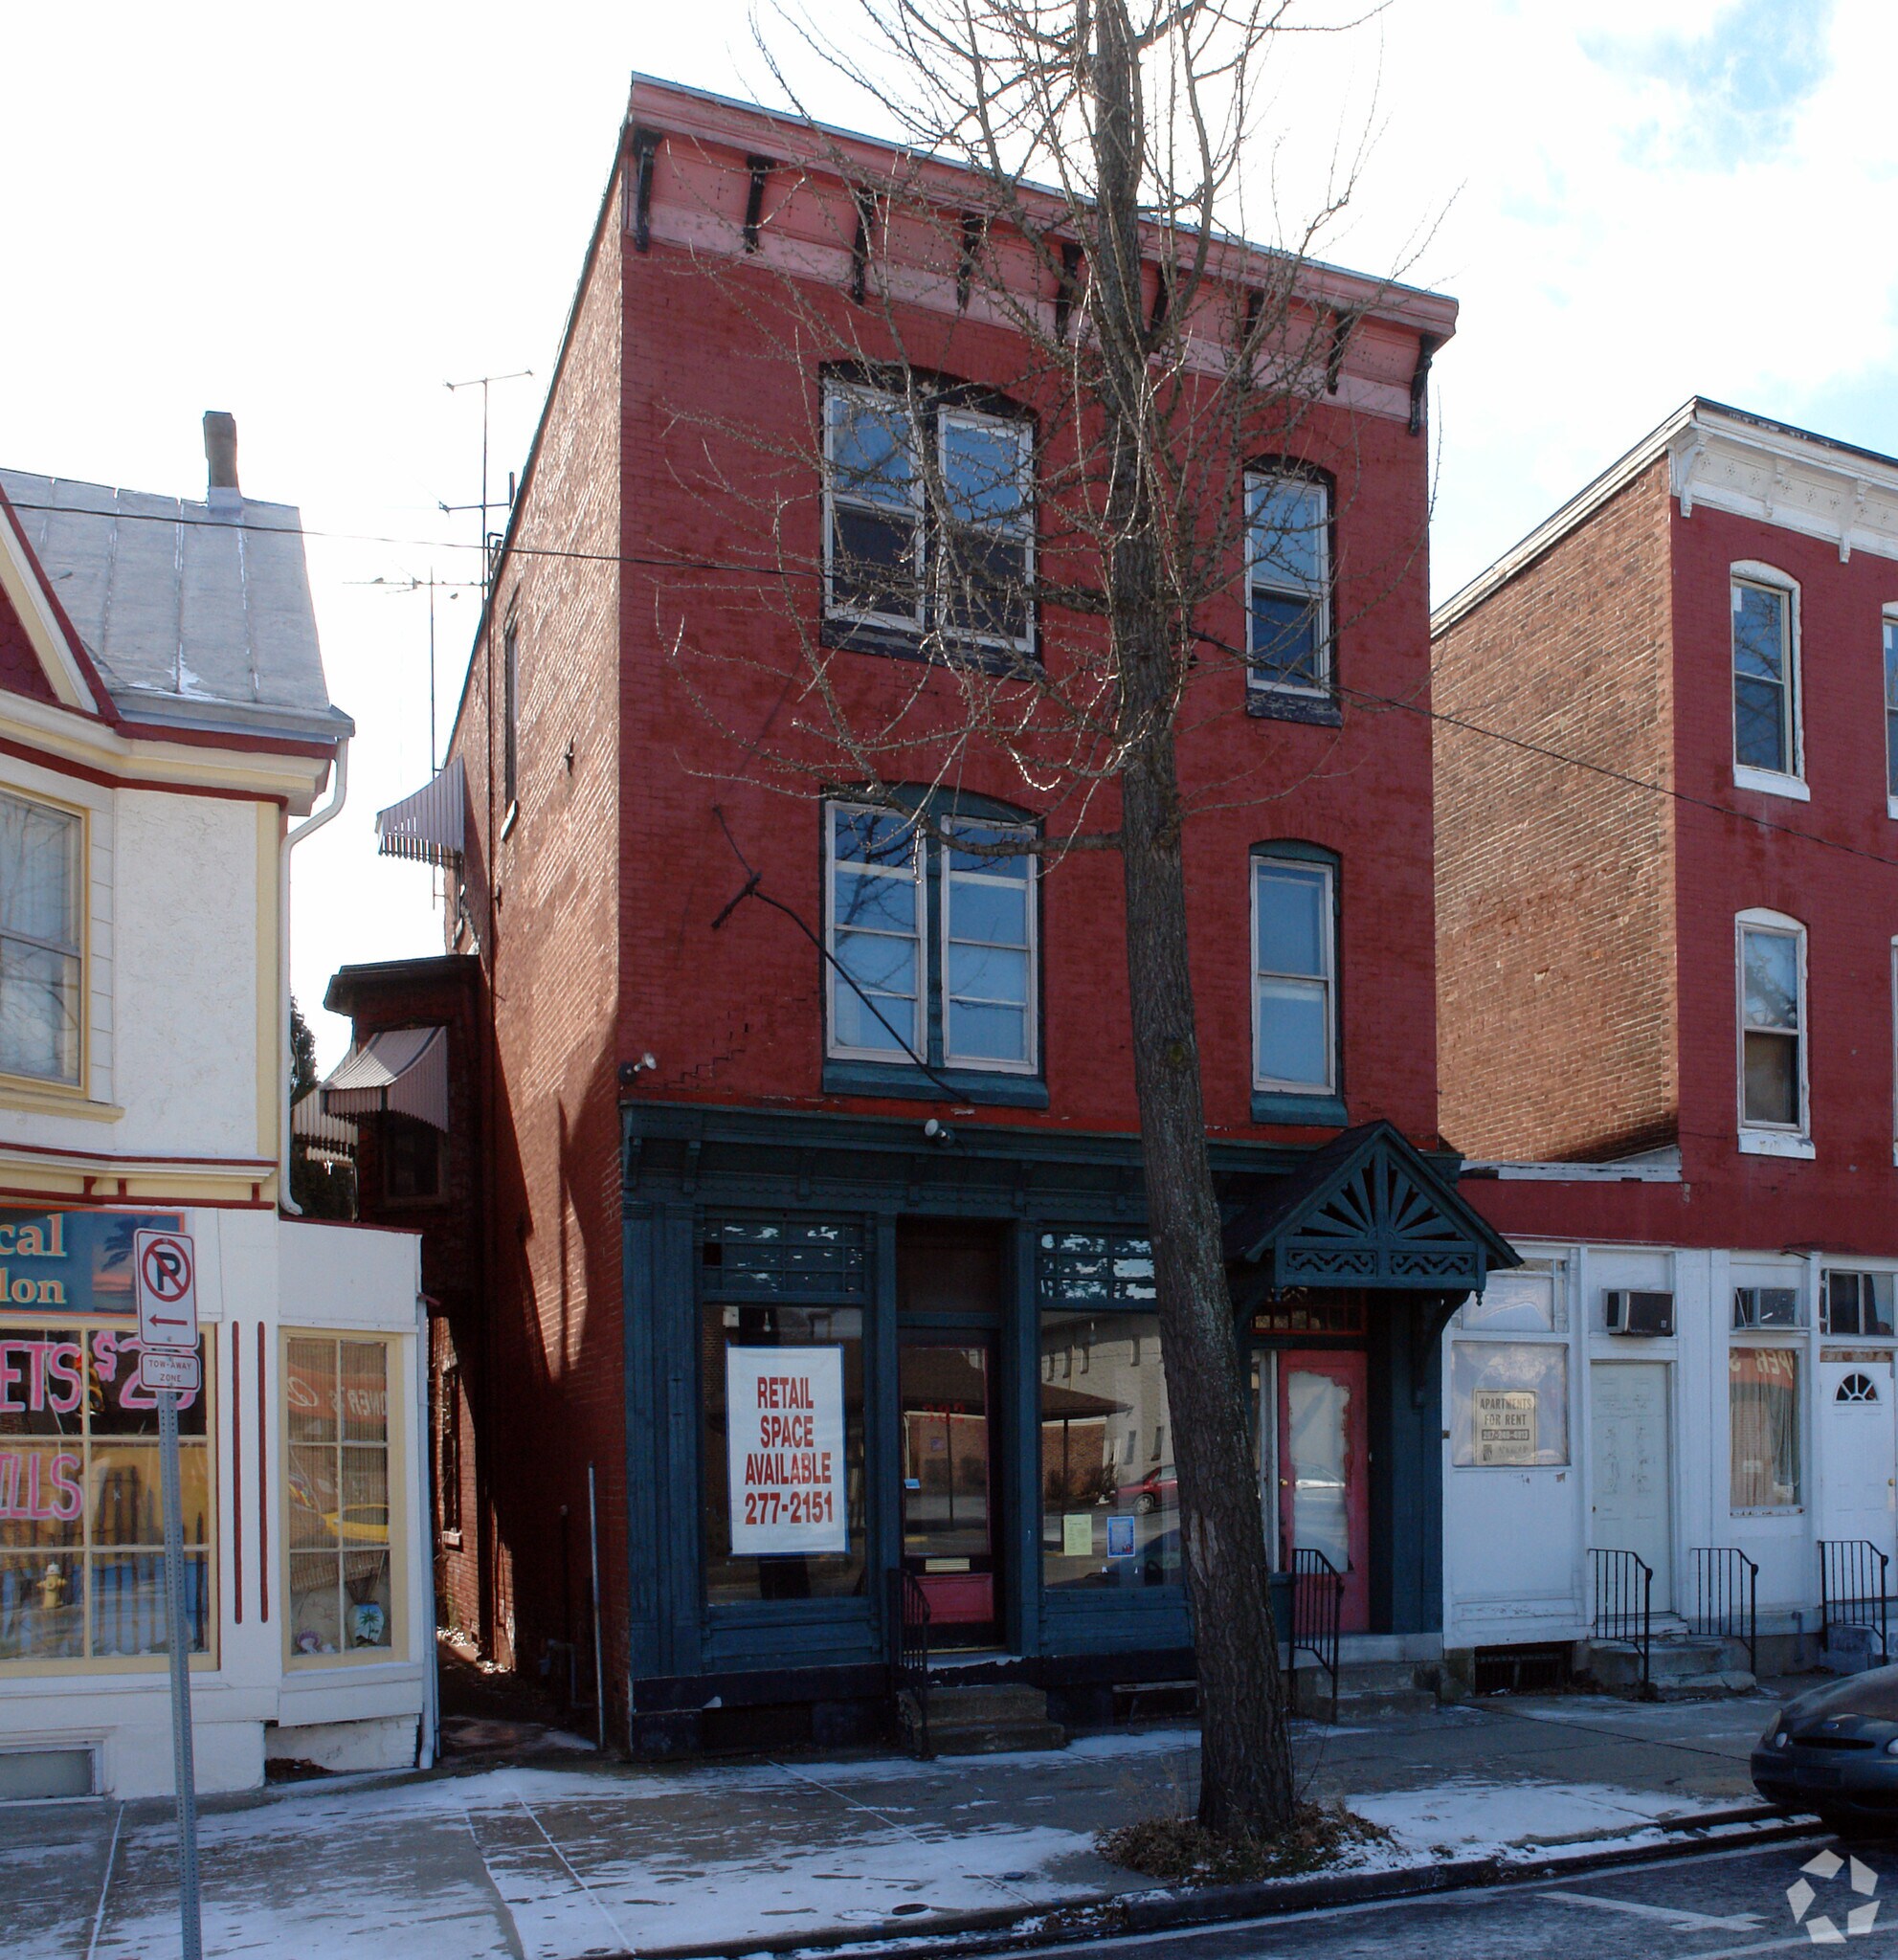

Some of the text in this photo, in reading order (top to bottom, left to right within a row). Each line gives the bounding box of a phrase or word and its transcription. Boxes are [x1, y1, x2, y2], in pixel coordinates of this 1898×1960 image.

[0, 1213, 68, 1258] cal
[0, 1267, 68, 1304] lon
[0, 1340, 83, 1414] ETS
[147, 1359, 192, 1370] TOW-AWAY
[160, 1372, 183, 1383] ZONE
[757, 1376, 815, 1409] RETAIL
[1480, 1397, 1531, 1410] APARTMENTS
[760, 1414, 815, 1448] SPACE
[1485, 1414, 1527, 1426] FOR RENT
[745, 1452, 832, 1485] AVAILABLE
[745, 1491, 833, 1525] 277-2151
